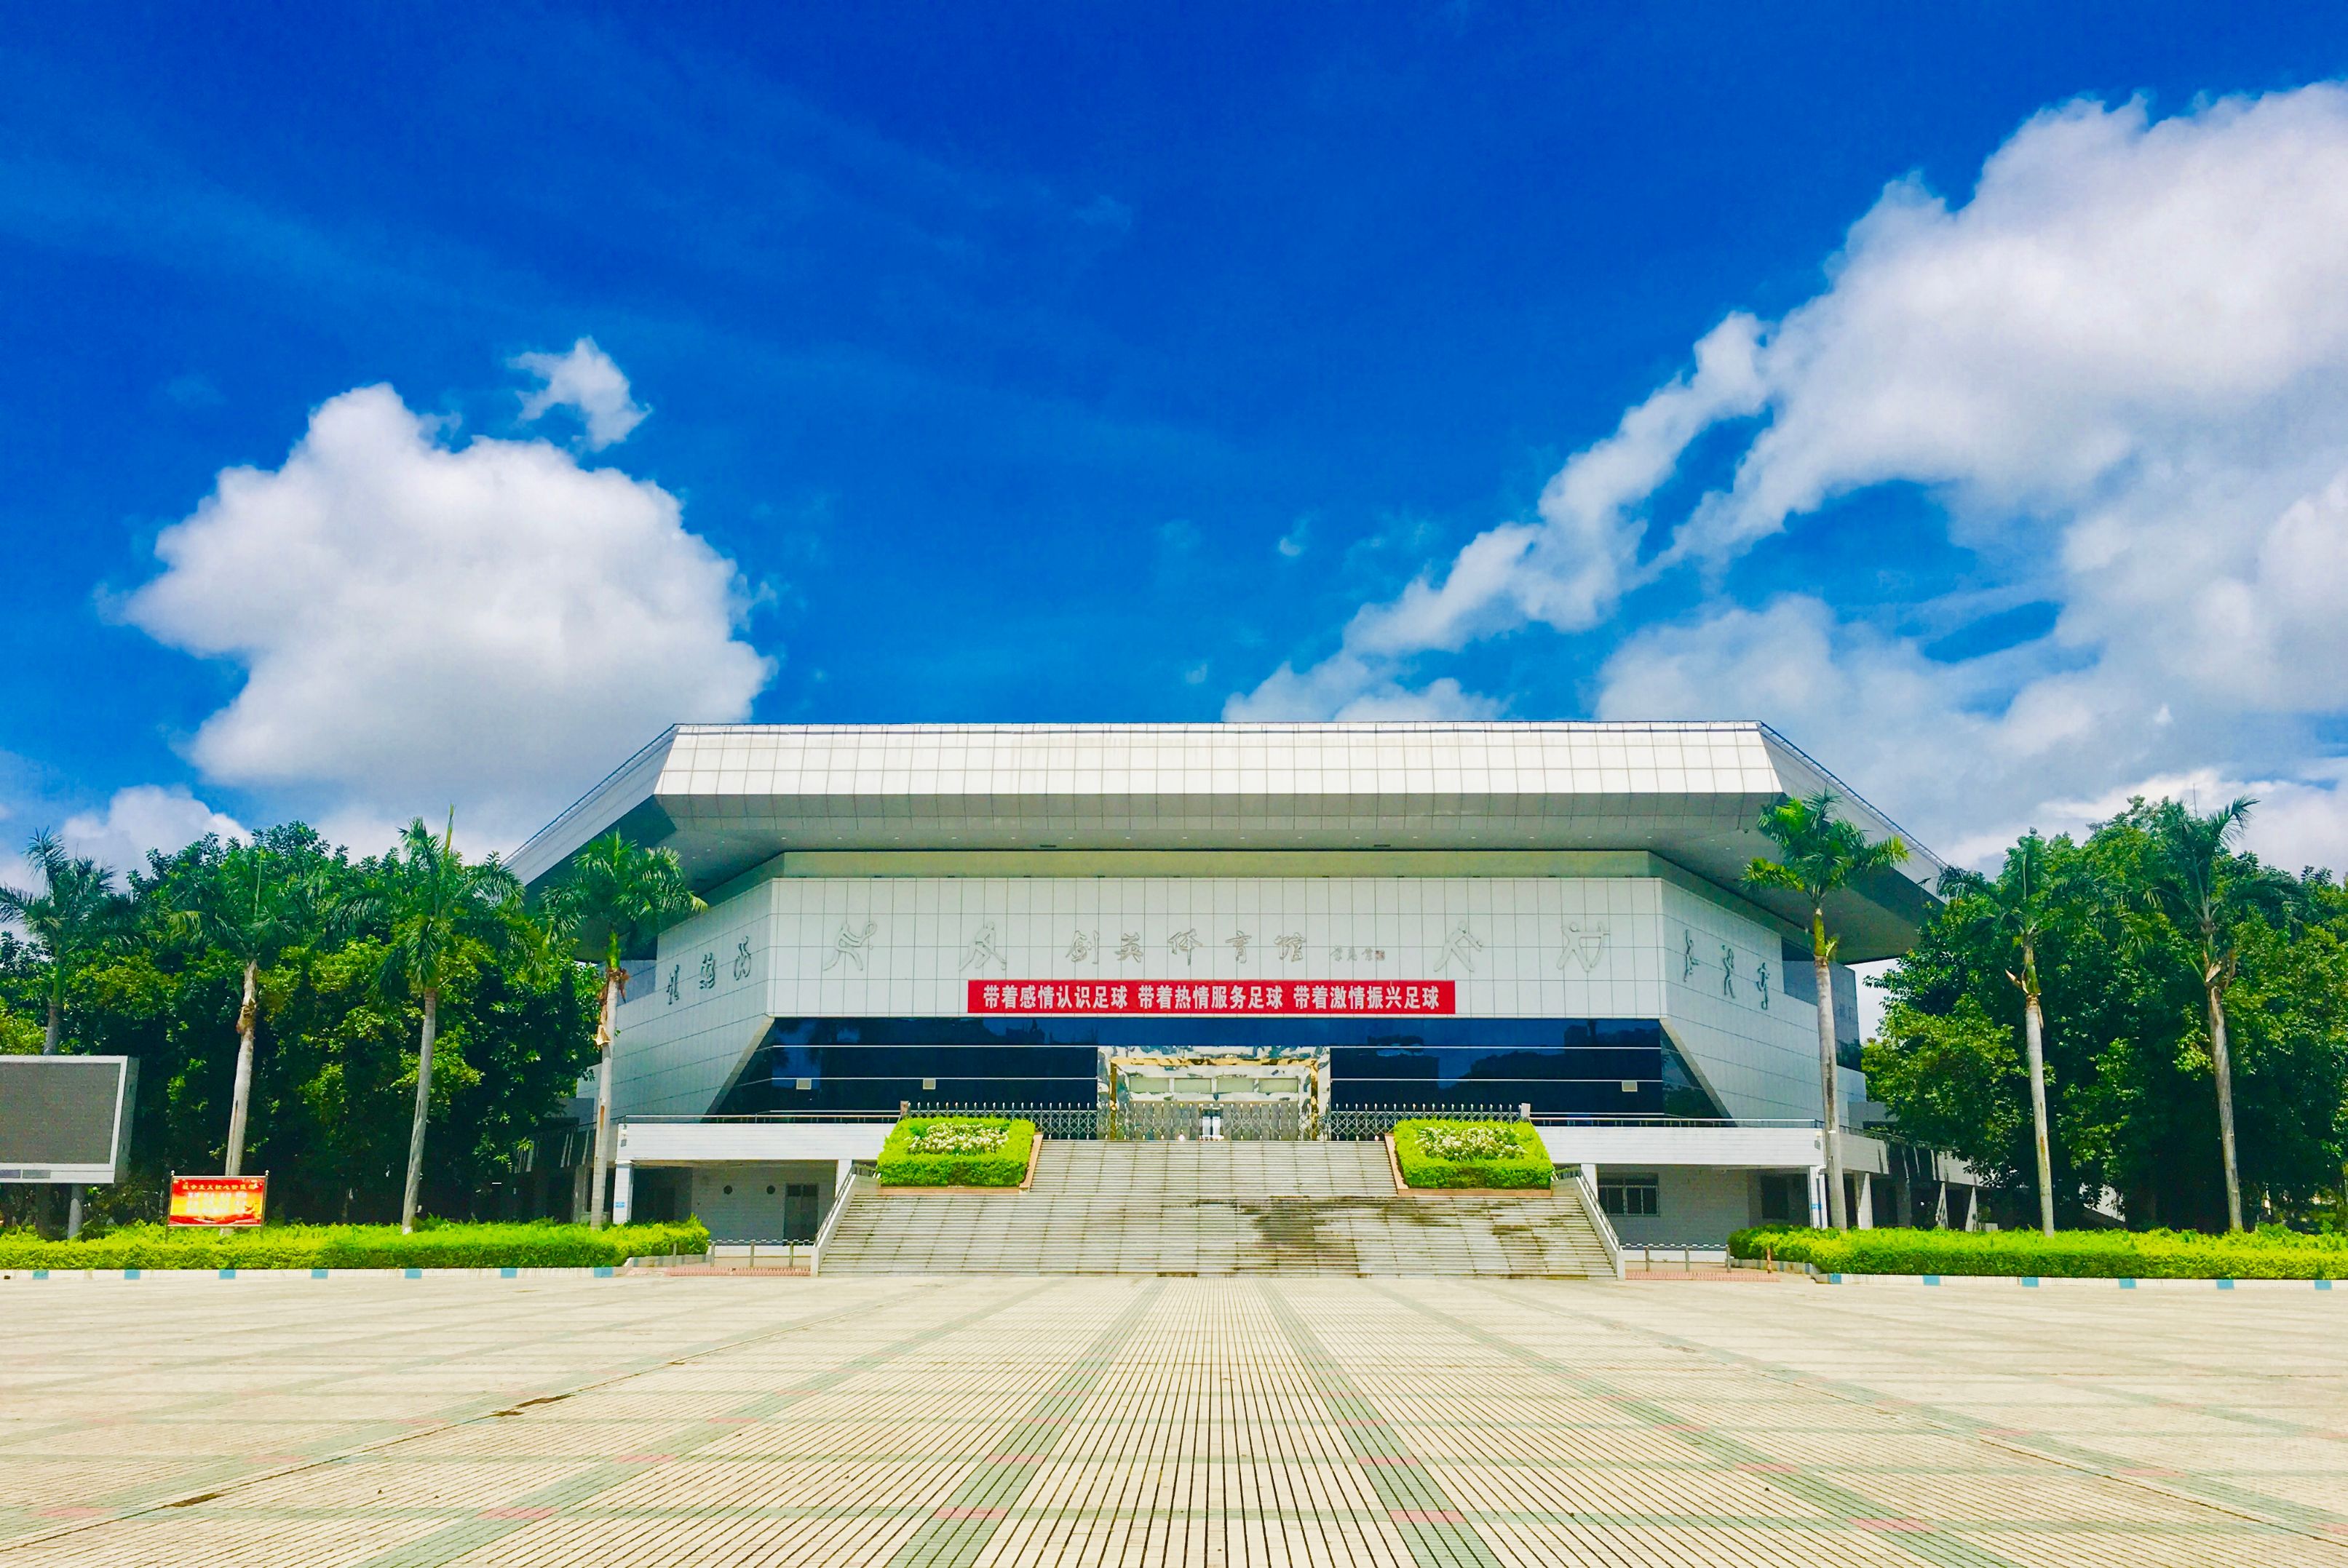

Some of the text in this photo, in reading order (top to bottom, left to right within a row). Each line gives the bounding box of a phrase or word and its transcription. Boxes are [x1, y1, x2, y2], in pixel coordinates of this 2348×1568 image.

[983, 984, 1440, 1010] 带着感情认识足球 带着热情服务足球 带着激情振兴足球
